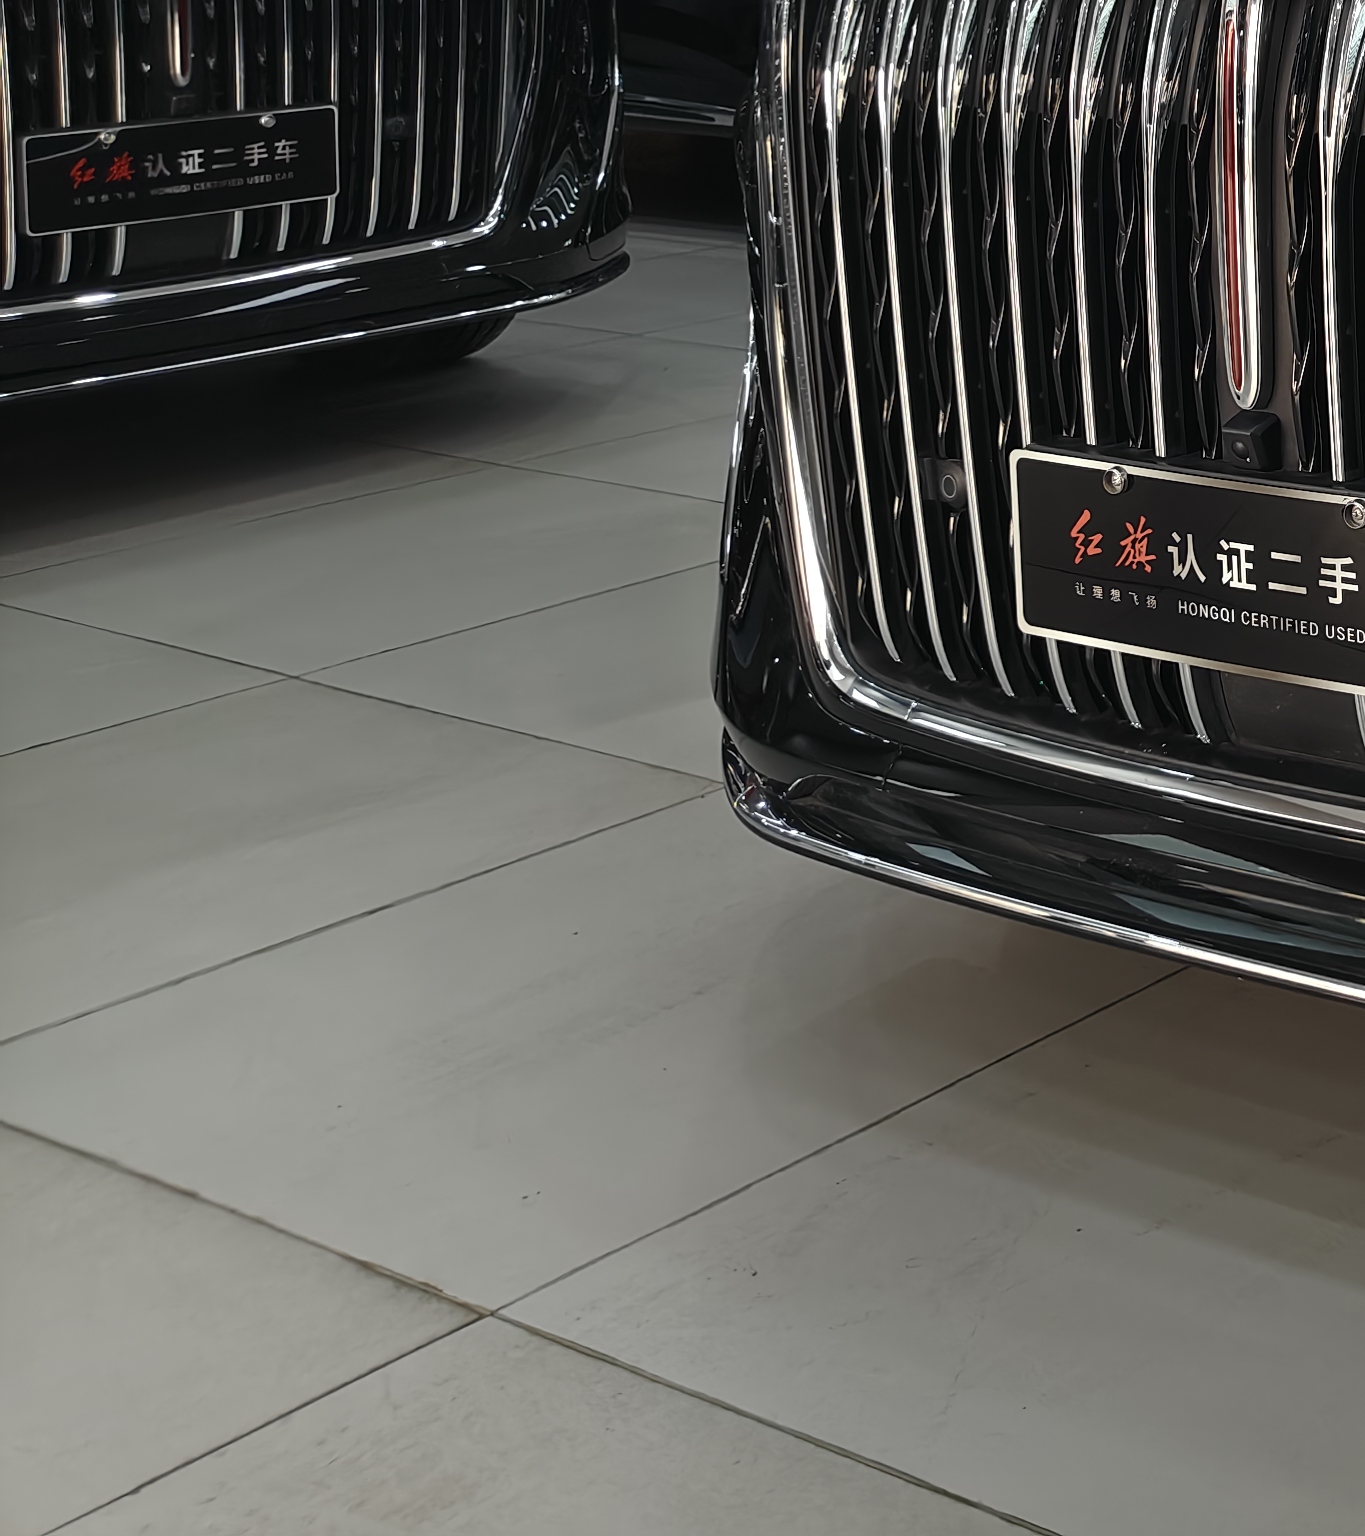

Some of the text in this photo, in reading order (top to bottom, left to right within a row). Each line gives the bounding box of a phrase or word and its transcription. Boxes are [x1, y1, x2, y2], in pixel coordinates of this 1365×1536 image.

[69, 138, 300, 190] 红旗认证二手车
[246, 173, 273, 185] USED
[1074, 581, 1158, 610] 让理想飞扬
[1178, 599, 1236, 623] HONGQI
[1240, 610, 1319, 637] CERTIFIED
[1325, 624, 1365, 645] USED
